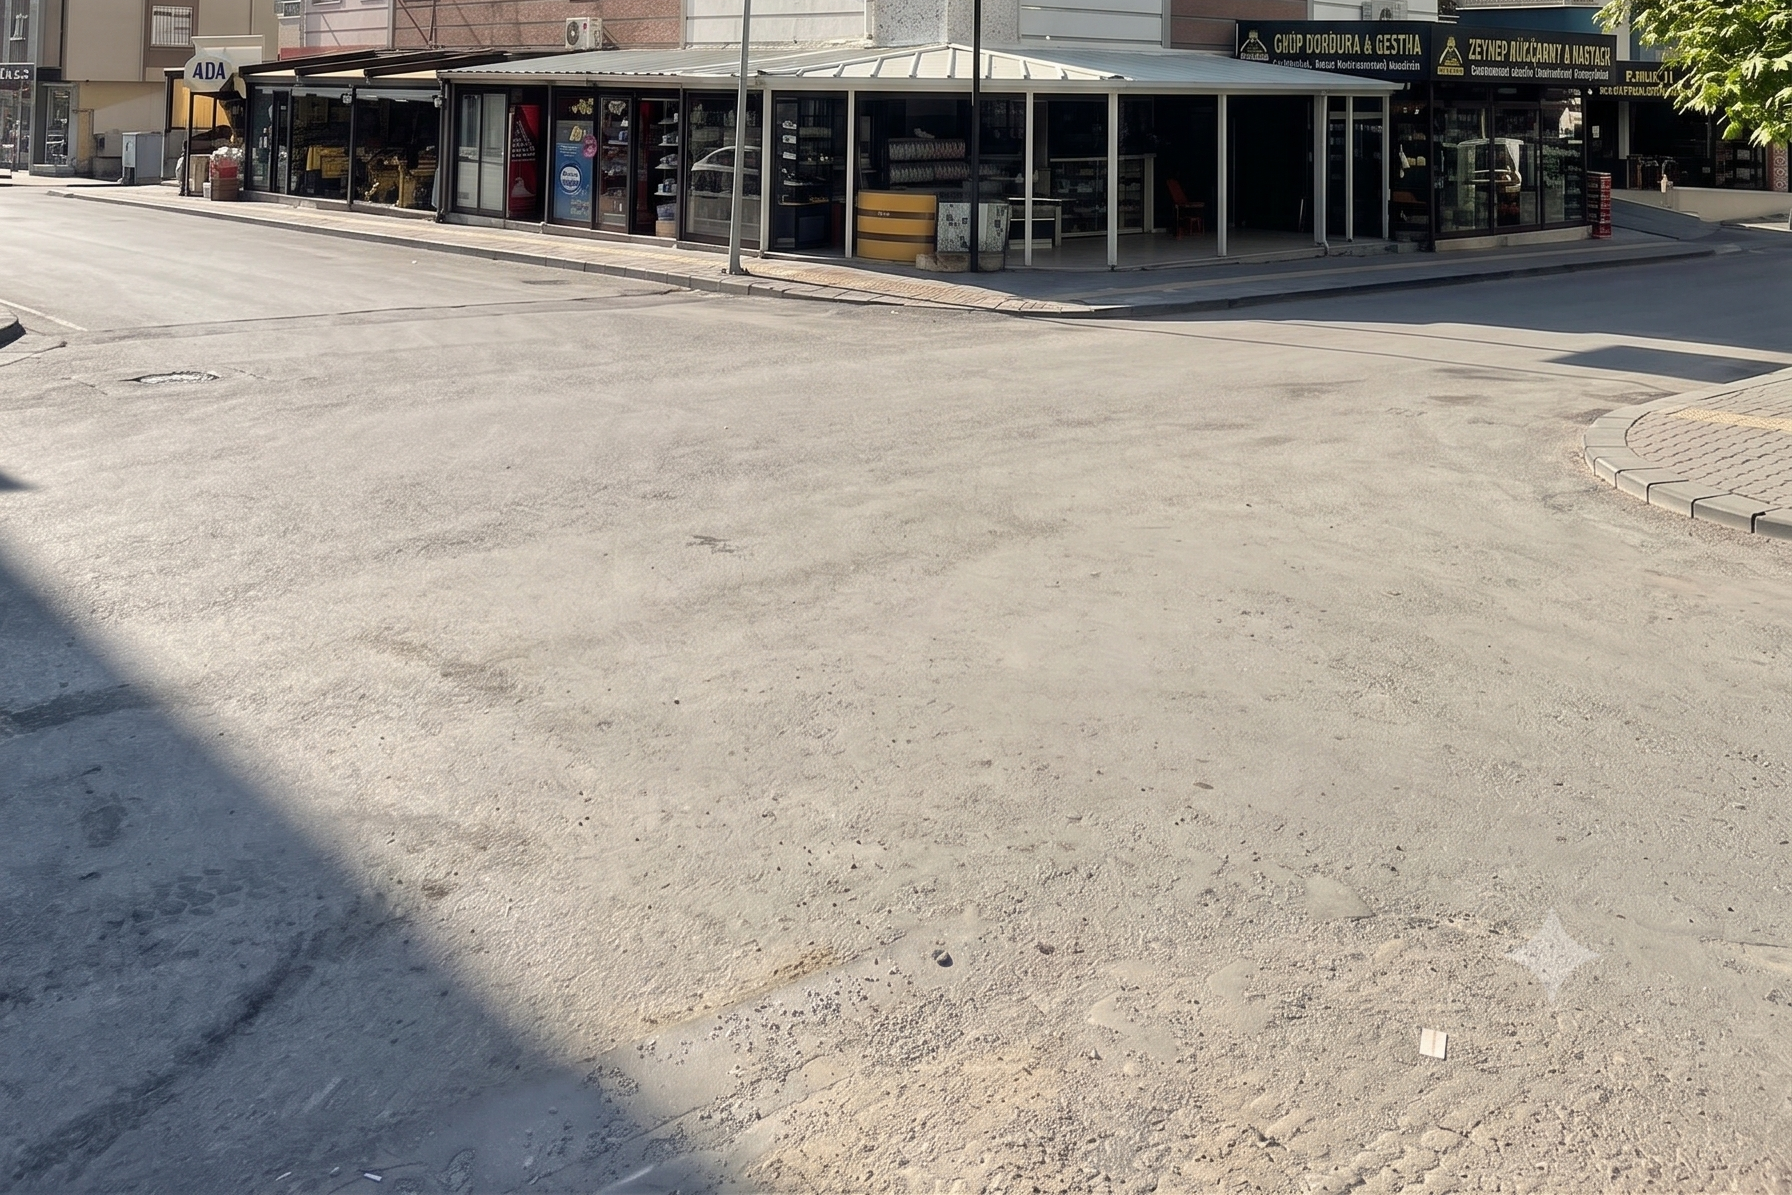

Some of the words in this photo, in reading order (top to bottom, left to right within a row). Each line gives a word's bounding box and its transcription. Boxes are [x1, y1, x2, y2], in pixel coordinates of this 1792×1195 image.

[1363, 34, 1373, 55] &
[1468, 38, 1508, 62] ZEYNEP
[192, 61, 226, 80] ADA
